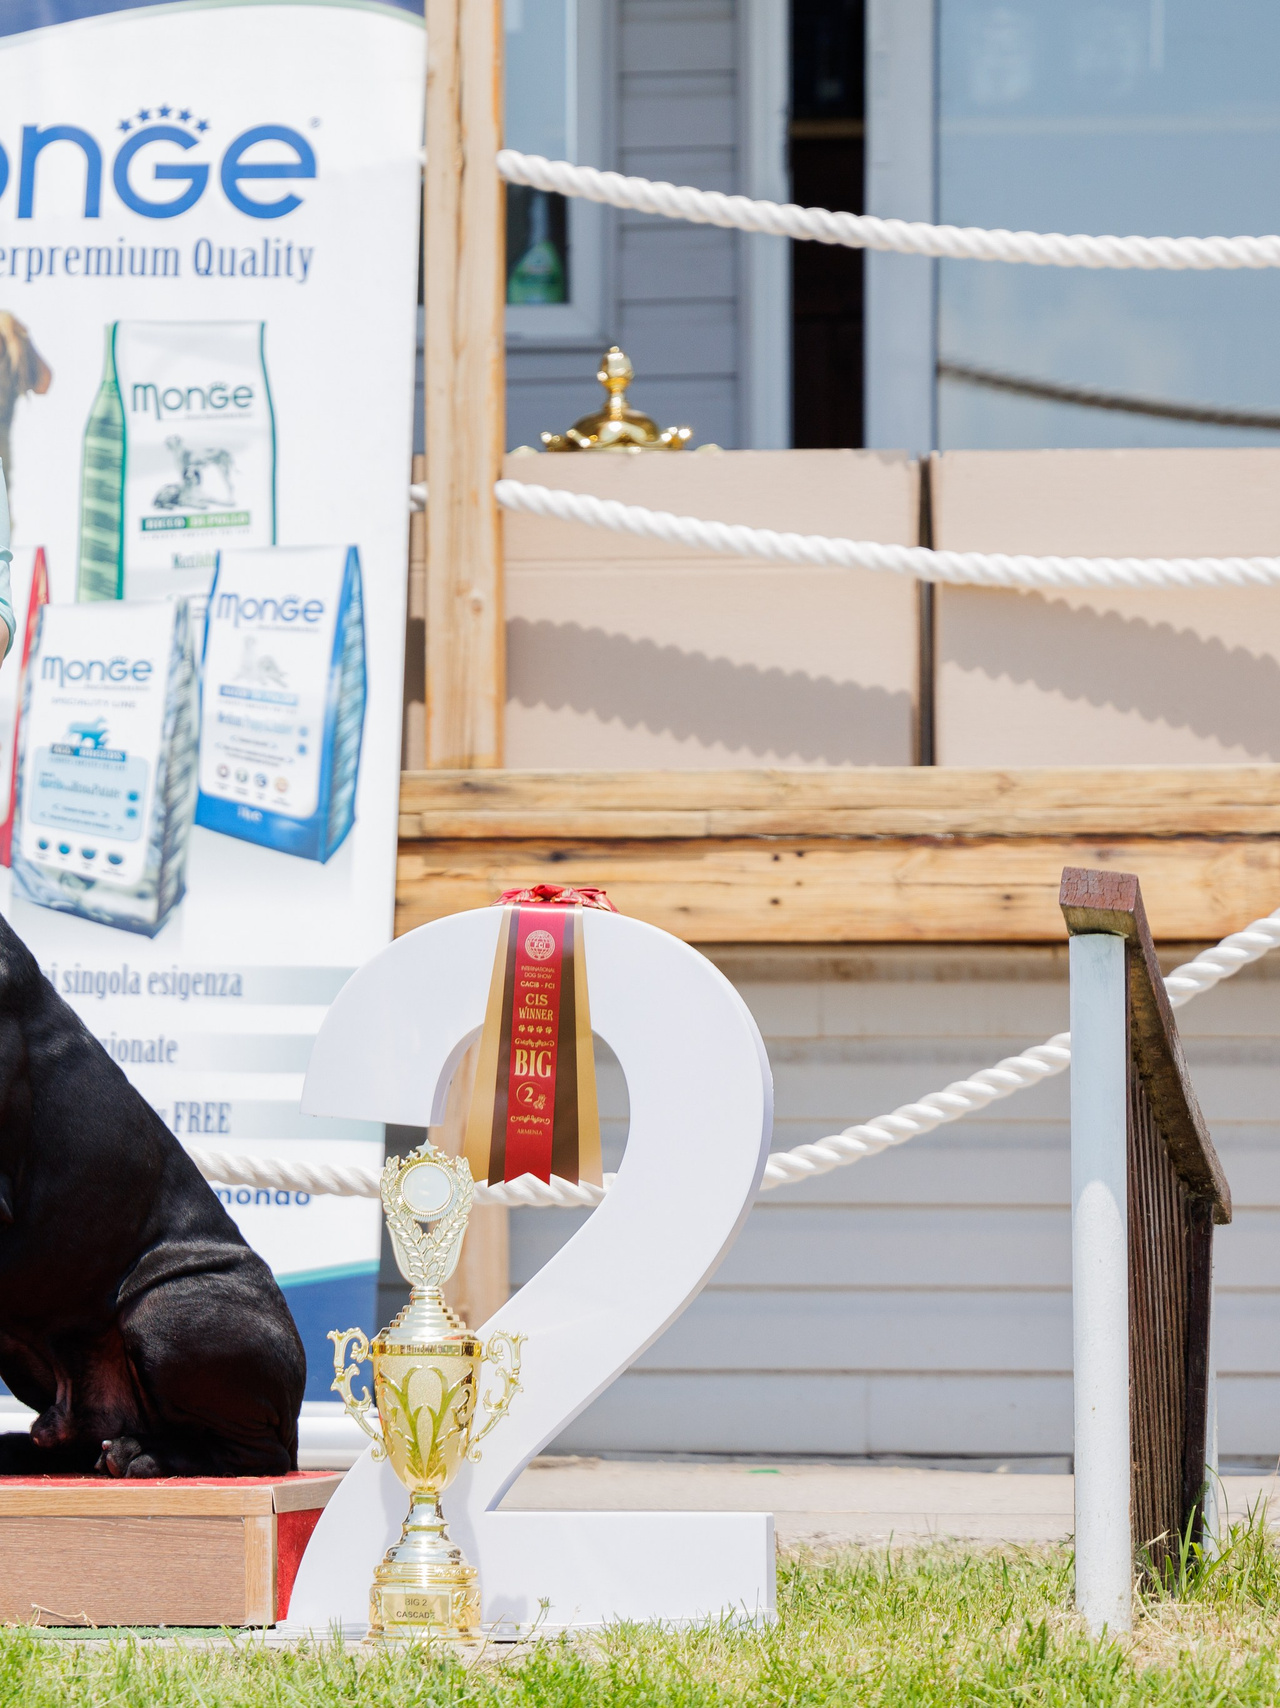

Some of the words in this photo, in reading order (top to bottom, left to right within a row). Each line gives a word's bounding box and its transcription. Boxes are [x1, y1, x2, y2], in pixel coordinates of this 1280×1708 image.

[191, 237, 315, 284] Quality
[521, 965, 556, 974] INTERNATIONAL
[524, 971, 537, 979] DOG
[537, 972, 553, 980] SHOW
[62, 963, 141, 1000] singola
[147, 964, 244, 1001] esigenza
[520, 980, 540, 988] CACIB
[544, 982, 556, 990] FCI
[525, 992, 549, 1007] CIS
[518, 1006, 554, 1022] WINNER
[514, 1048, 552, 1079] BIG
[523, 1086, 535, 1104] 2
[173, 1101, 232, 1134] FREE
[516, 1128, 543, 1136] ARMENIA
[422, 1599, 428, 1607] 2
